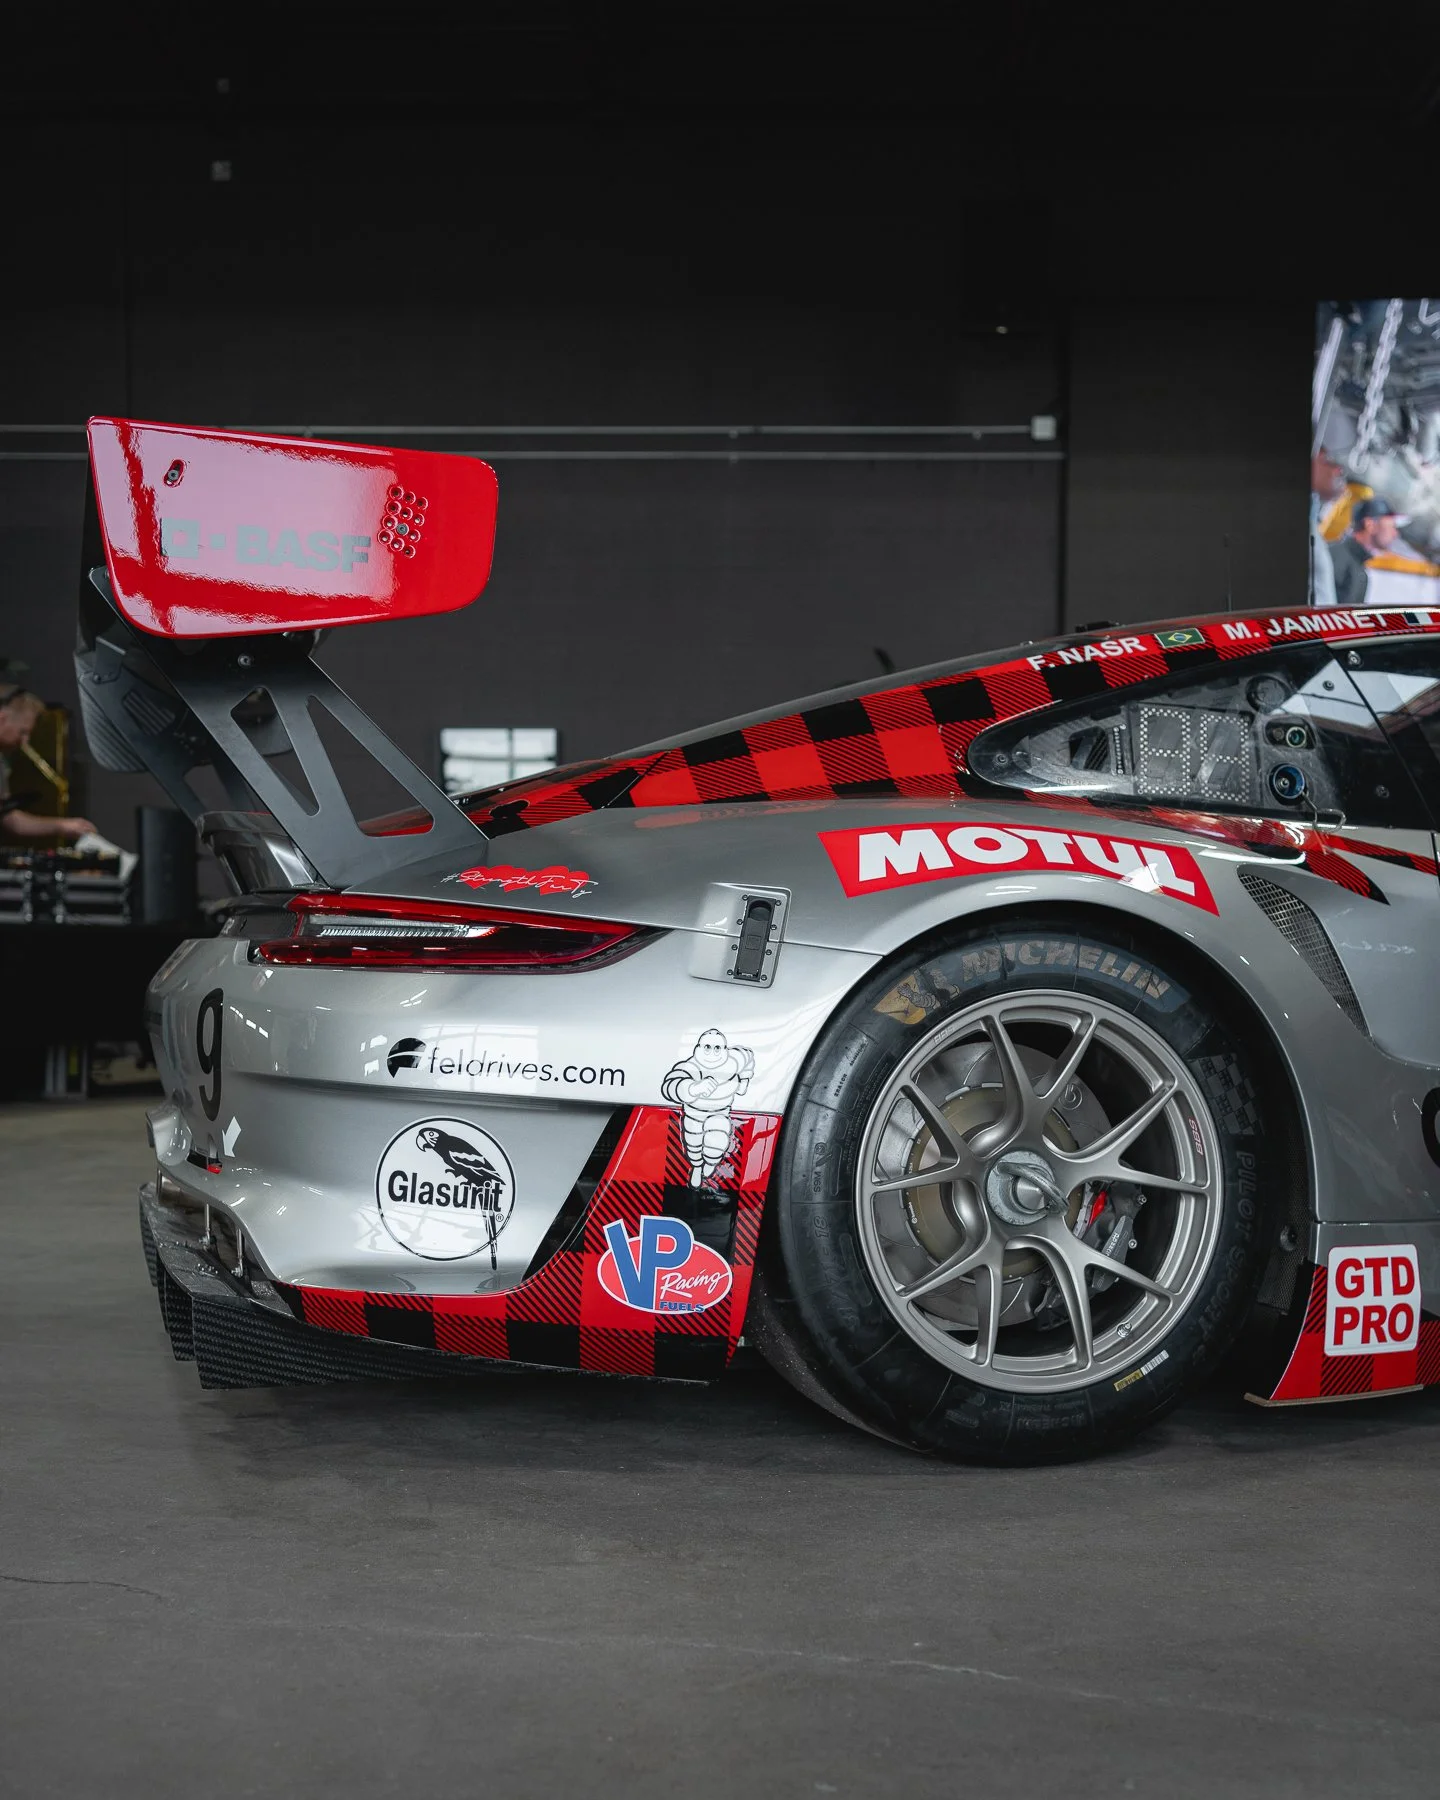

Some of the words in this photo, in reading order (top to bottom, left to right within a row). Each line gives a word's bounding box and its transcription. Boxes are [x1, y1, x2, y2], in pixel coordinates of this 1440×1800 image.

[236, 525, 371, 573] BASF
[1226, 622, 1260, 640] M.
[1267, 611, 1389, 636] JAMINET
[1026, 655, 1056, 671] F.
[1057, 637, 1148, 665] NASR
[859, 826, 1196, 897] MOTUL
[962, 939, 1173, 1000] MICHELIN
[197, 988, 224, 1122] 9
[428, 1046, 626, 1087] feldrives.com
[387, 1170, 503, 1213] Glasurit
[603, 1215, 694, 1311] VP
[660, 1268, 730, 1300] Racing
[1335, 1256, 1415, 1299] GTD
[659, 1301, 705, 1313] FUELS
[1333, 1302, 1415, 1346] PRO
